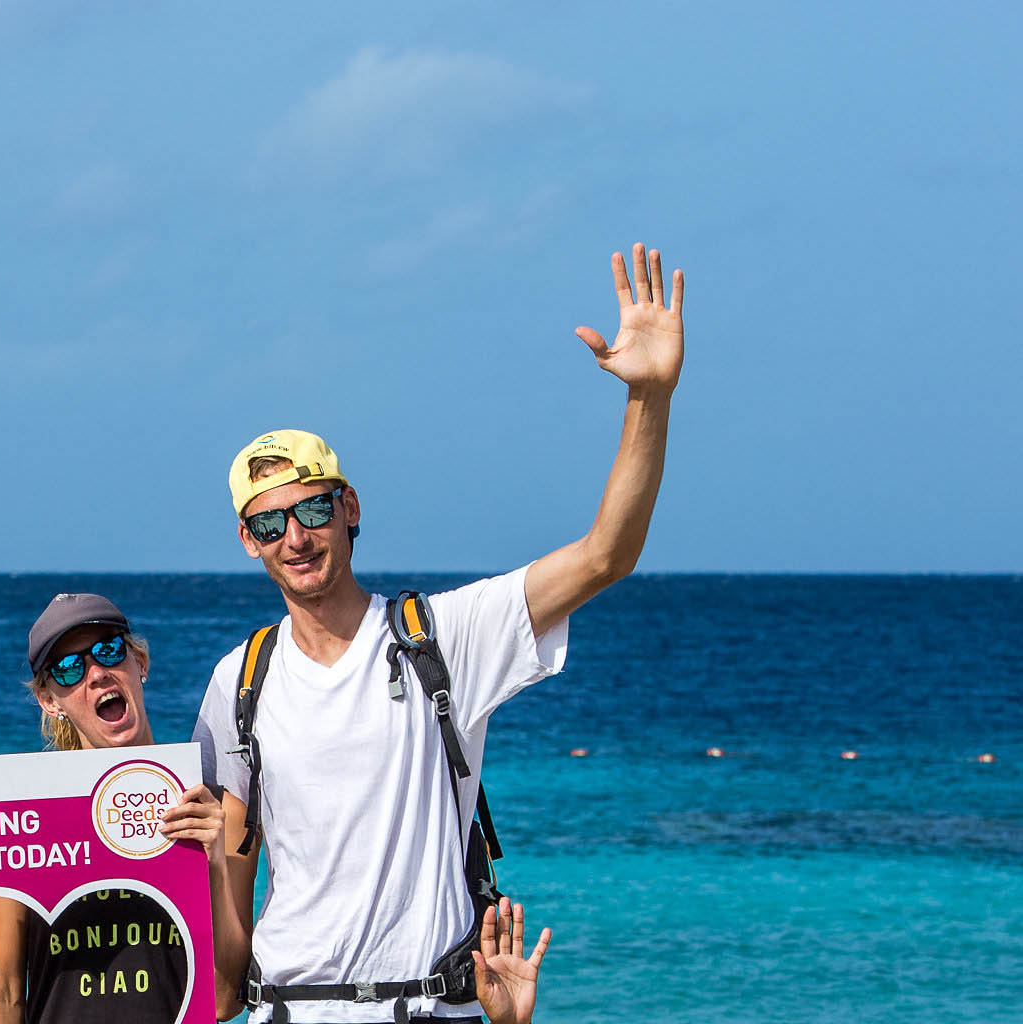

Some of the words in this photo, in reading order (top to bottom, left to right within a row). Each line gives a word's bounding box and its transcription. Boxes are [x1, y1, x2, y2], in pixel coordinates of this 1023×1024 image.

[105, 804, 166, 825] Deeds
[120, 822, 160, 839] Day
[50, 922, 181, 955] BONJOUR
[79, 969, 149, 997] CIAO
